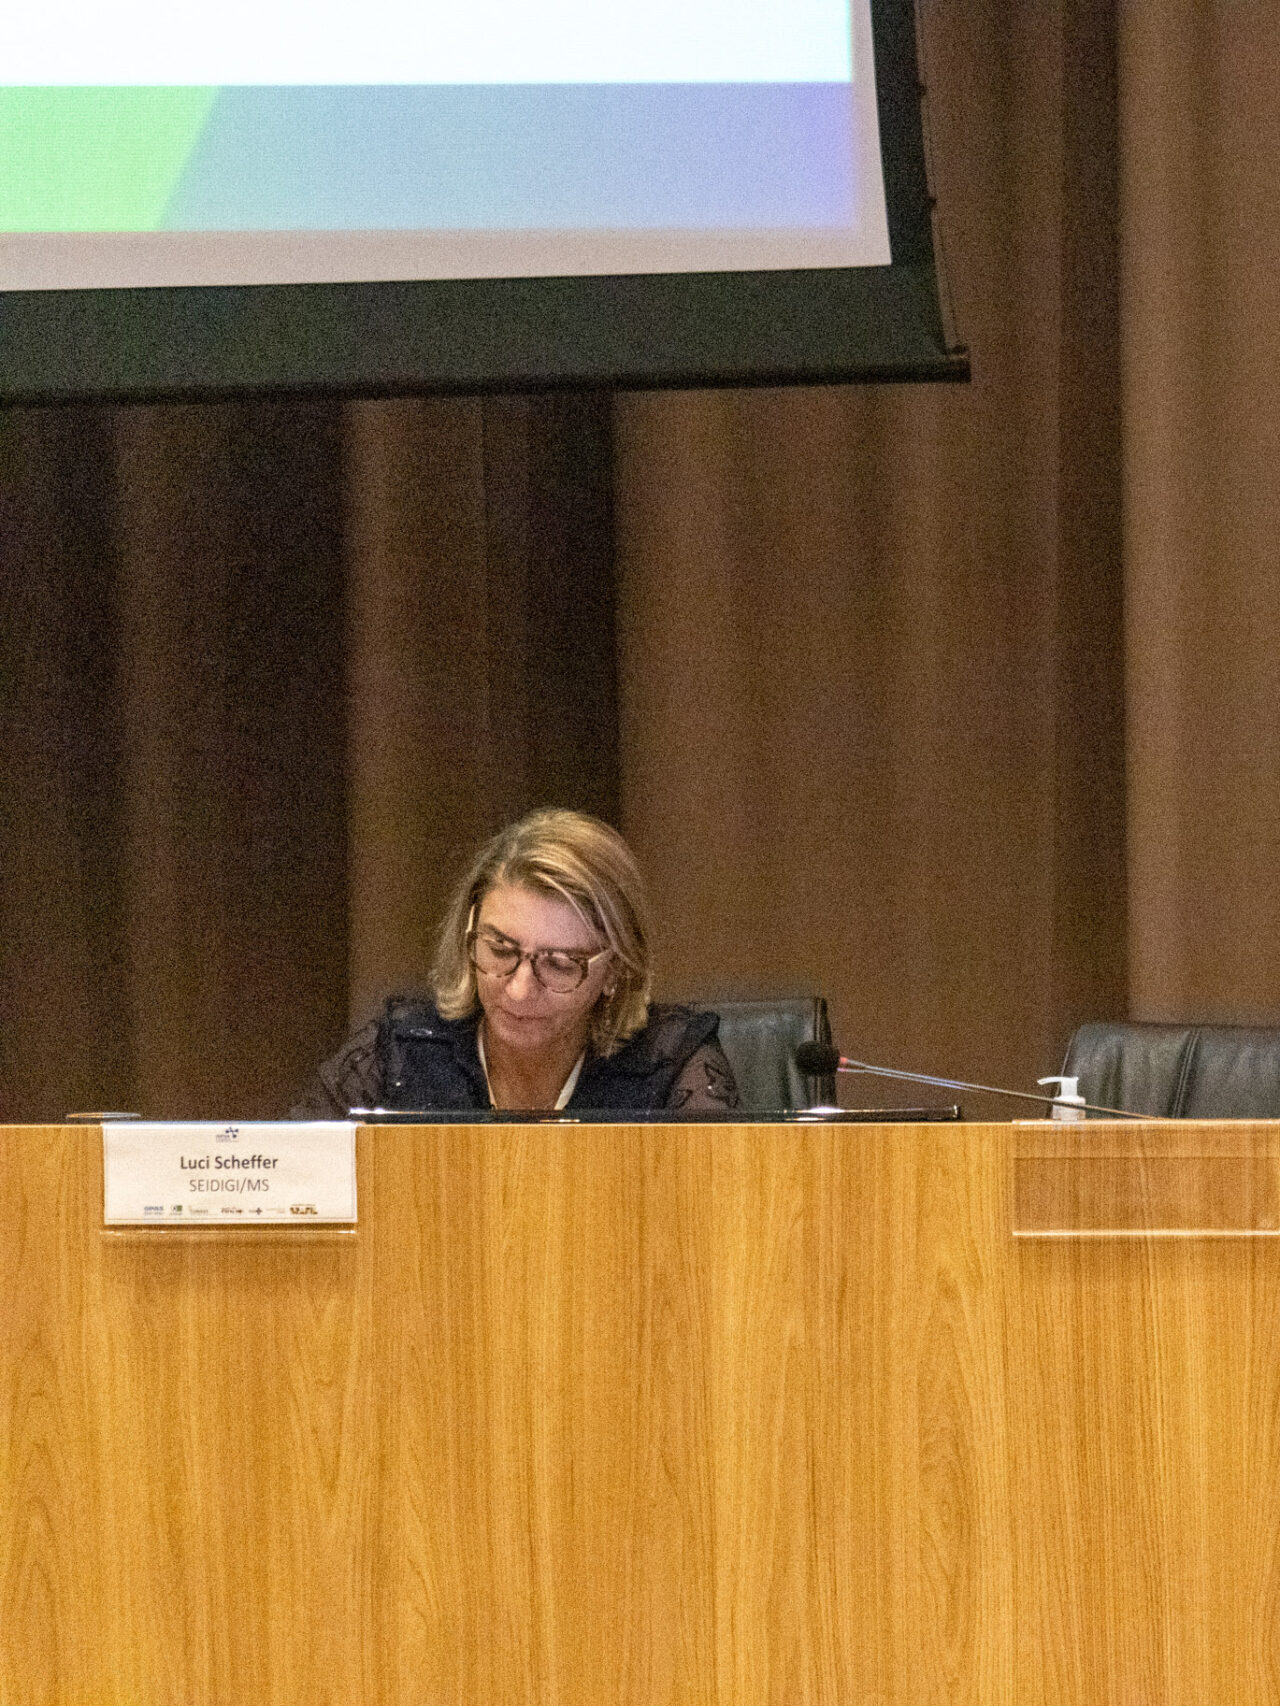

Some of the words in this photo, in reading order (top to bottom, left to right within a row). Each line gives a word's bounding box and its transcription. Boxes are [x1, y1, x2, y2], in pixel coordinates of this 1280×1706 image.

[180, 1155, 210, 1169] Luci
[214, 1154, 279, 1169] Scheffer
[189, 1178, 270, 1194] SEIDIGI/MS
